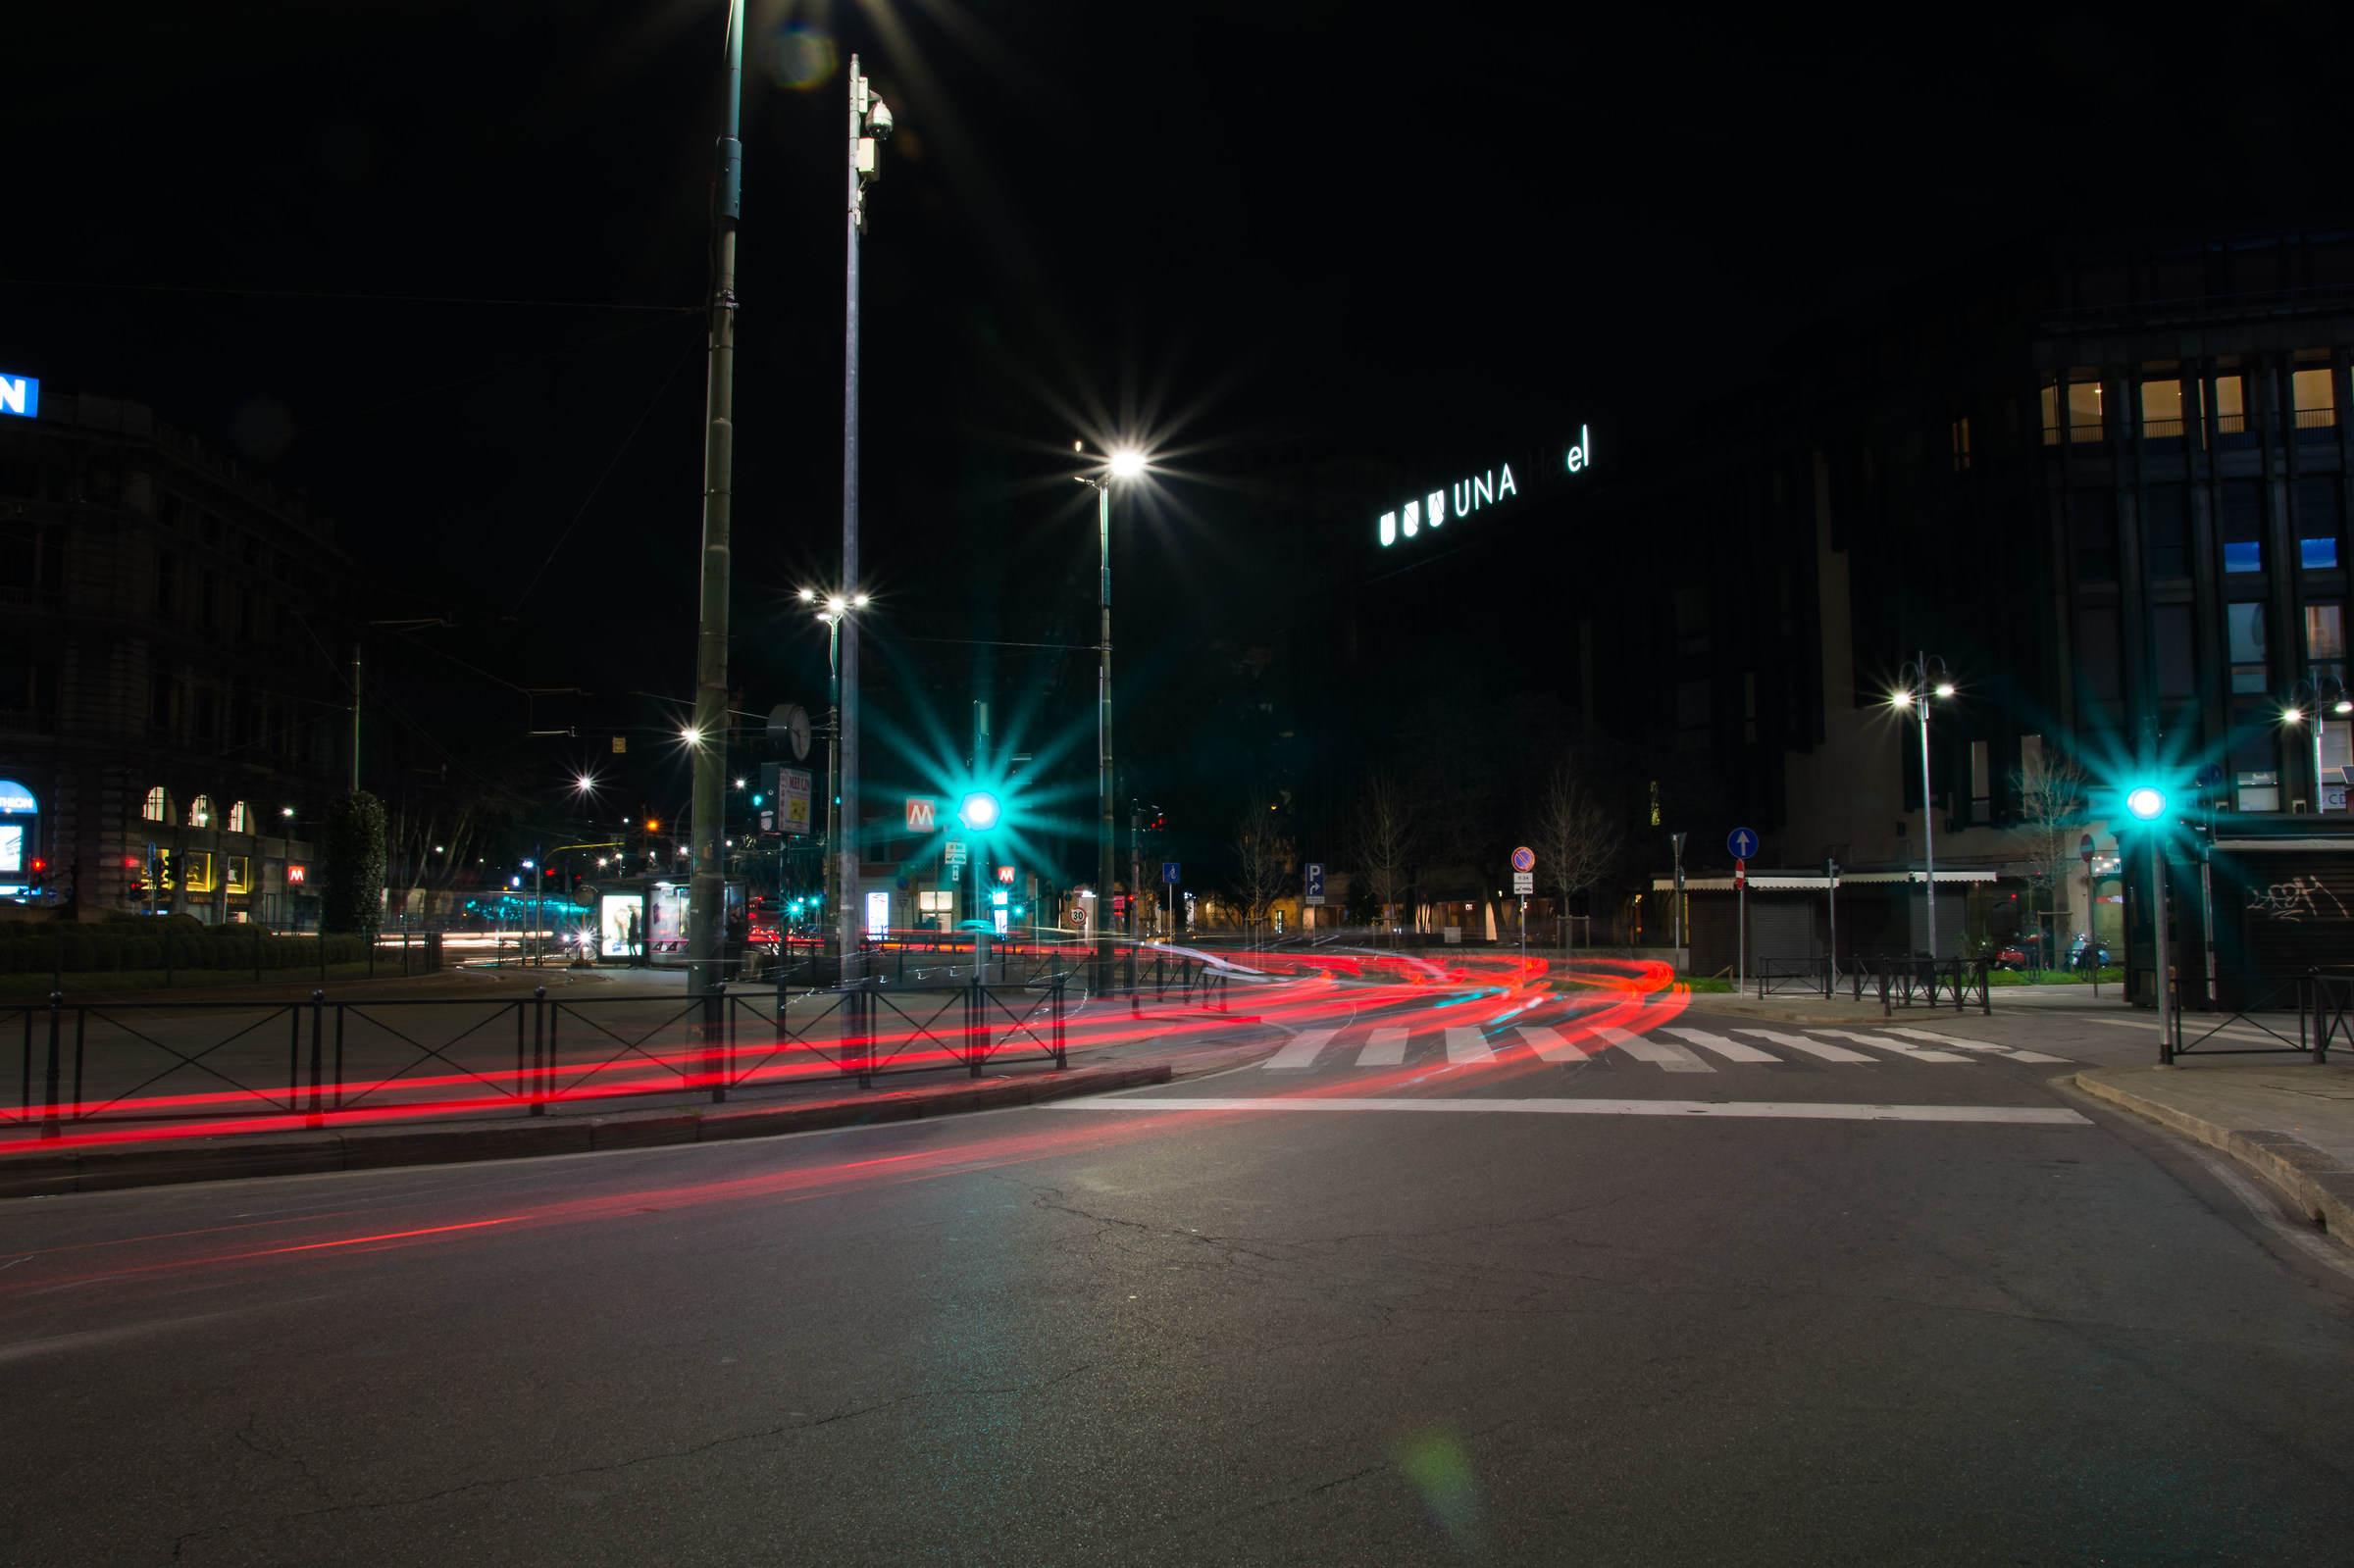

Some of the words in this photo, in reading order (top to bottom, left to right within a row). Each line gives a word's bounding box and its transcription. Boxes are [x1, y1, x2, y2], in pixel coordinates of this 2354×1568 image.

[0, 377, 26, 413] N
[1455, 463, 1517, 518] UNA
[909, 805, 934, 826] M
[290, 870, 304, 881] M
[1000, 870, 1013, 882] M
[1309, 865, 1321, 882] P
[1073, 911, 1084, 921] 30
